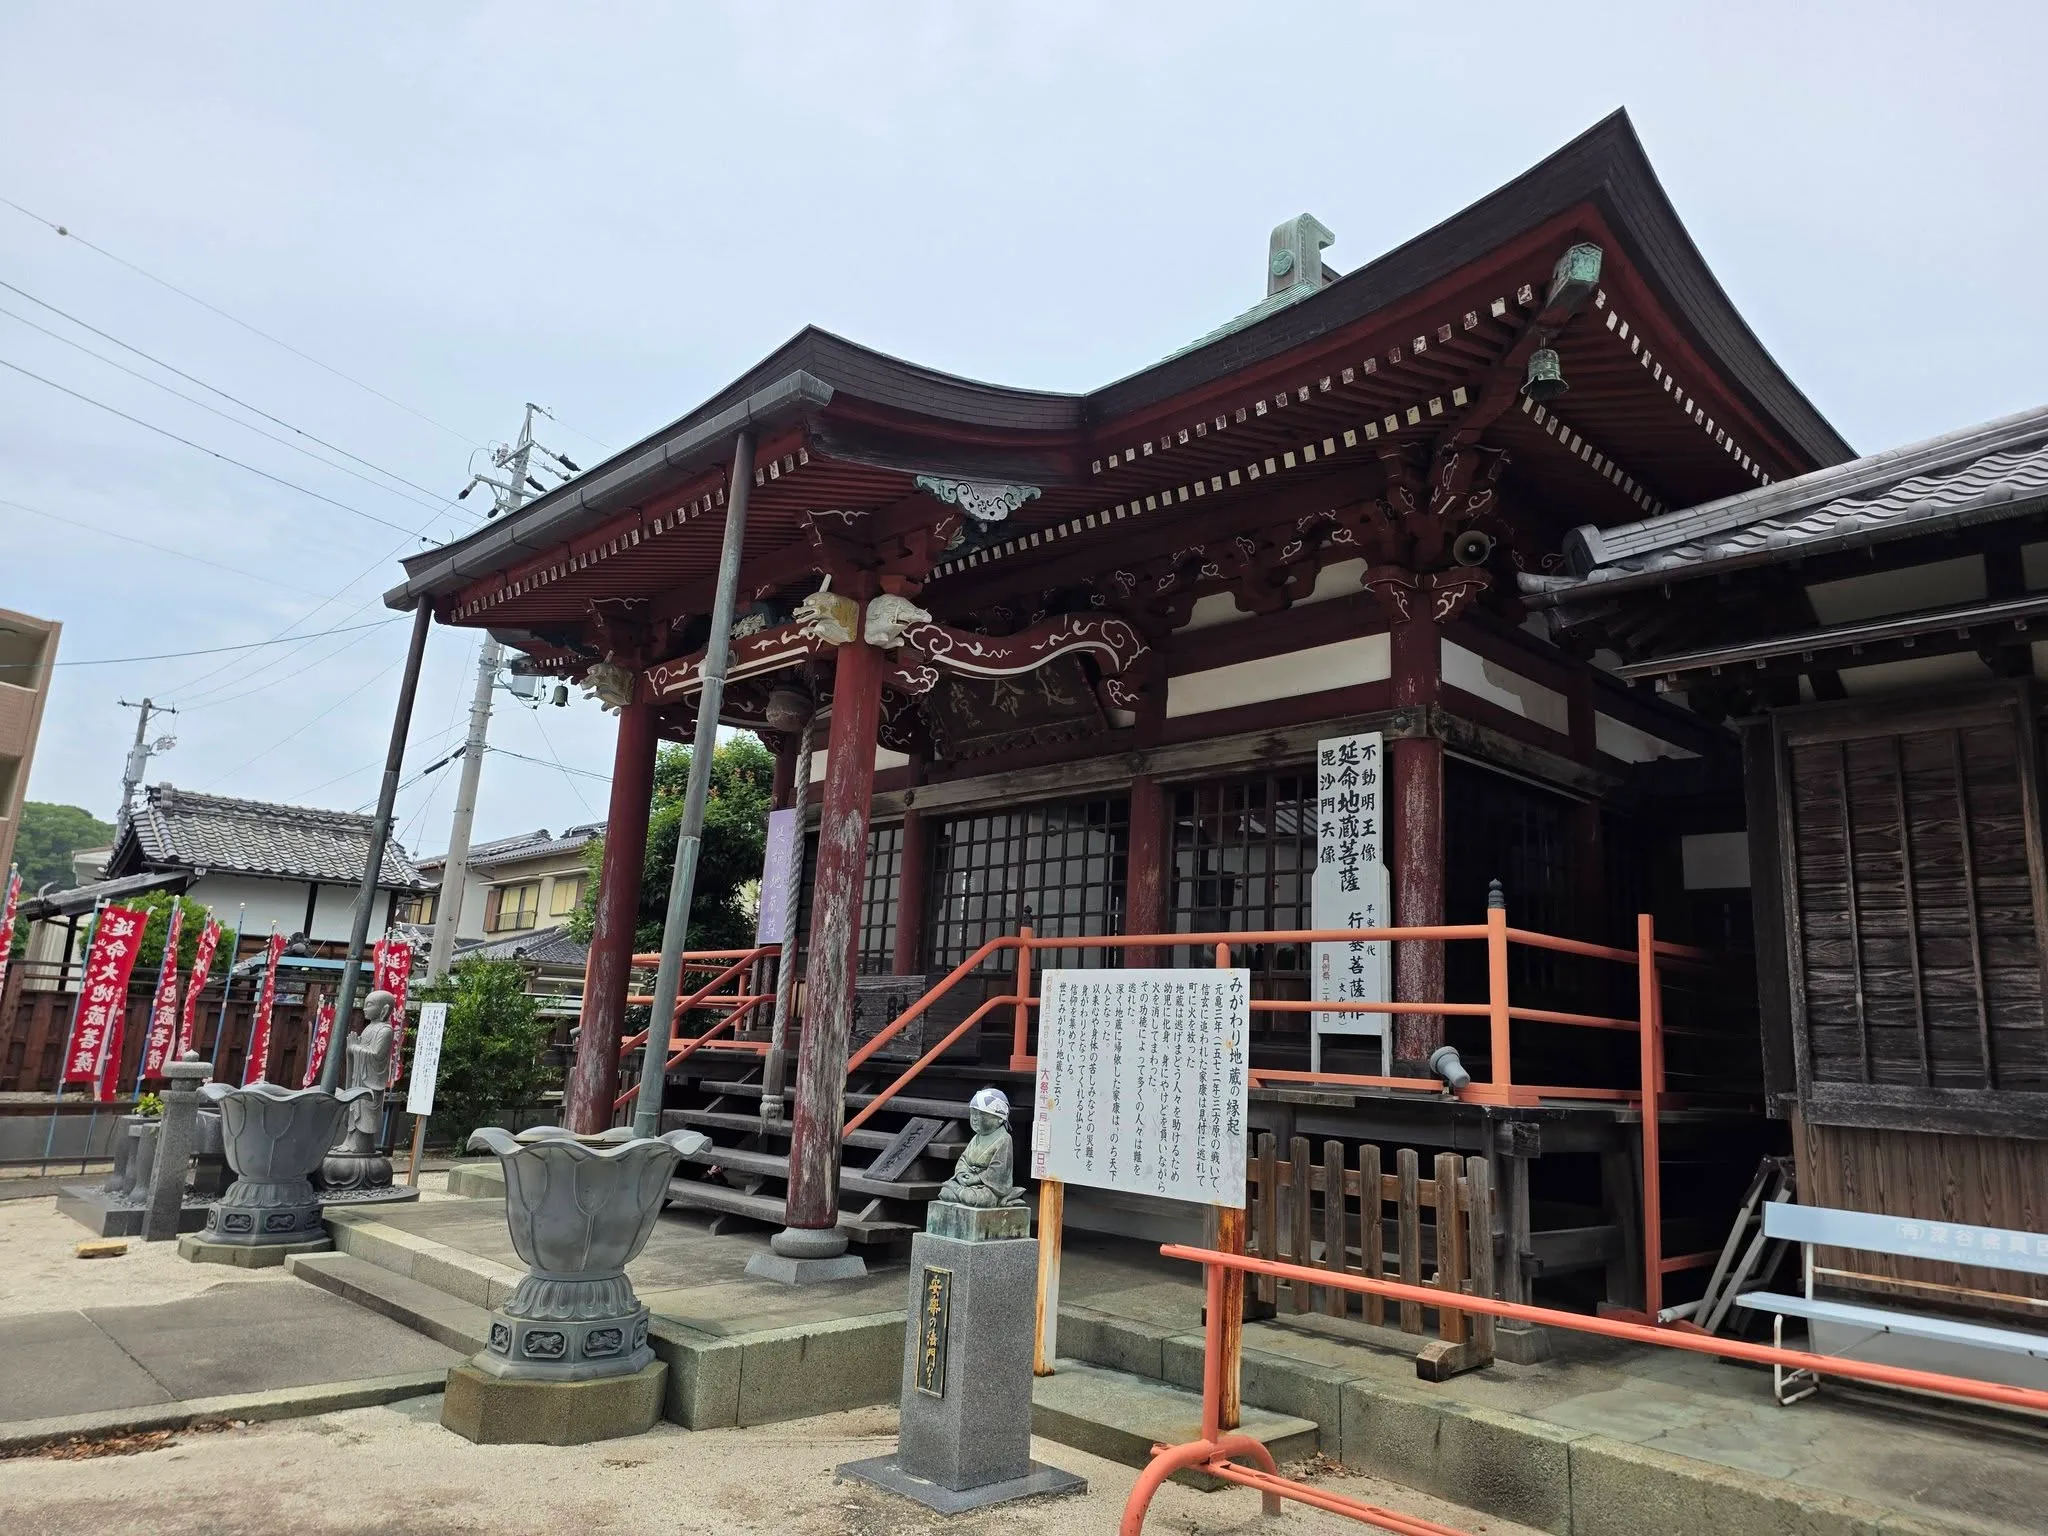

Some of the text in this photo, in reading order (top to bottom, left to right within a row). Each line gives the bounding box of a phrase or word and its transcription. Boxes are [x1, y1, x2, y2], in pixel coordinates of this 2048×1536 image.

[1320, 749, 1336, 864] 毘沙門天像
[1337, 740, 1361, 893] 延命地蔵菩薩
[1360, 743, 1377, 863] 不動明王像
[1066, 984, 1078, 1080] 信仰を集めている。
[1102, 983, 1113, 1047] 人となった。
[1127, 982, 1136, 1024] 逃れた。
[1149, 982, 1161, 1093] 火を消してまわった。
[1186, 982, 1197, 1068] 町に火を放った
[1226, 976, 1243, 1136] みがわり地蔵の縁起
[1170, 983, 1185, 1182] 地蔵は逃げまどう人々を助けるため
